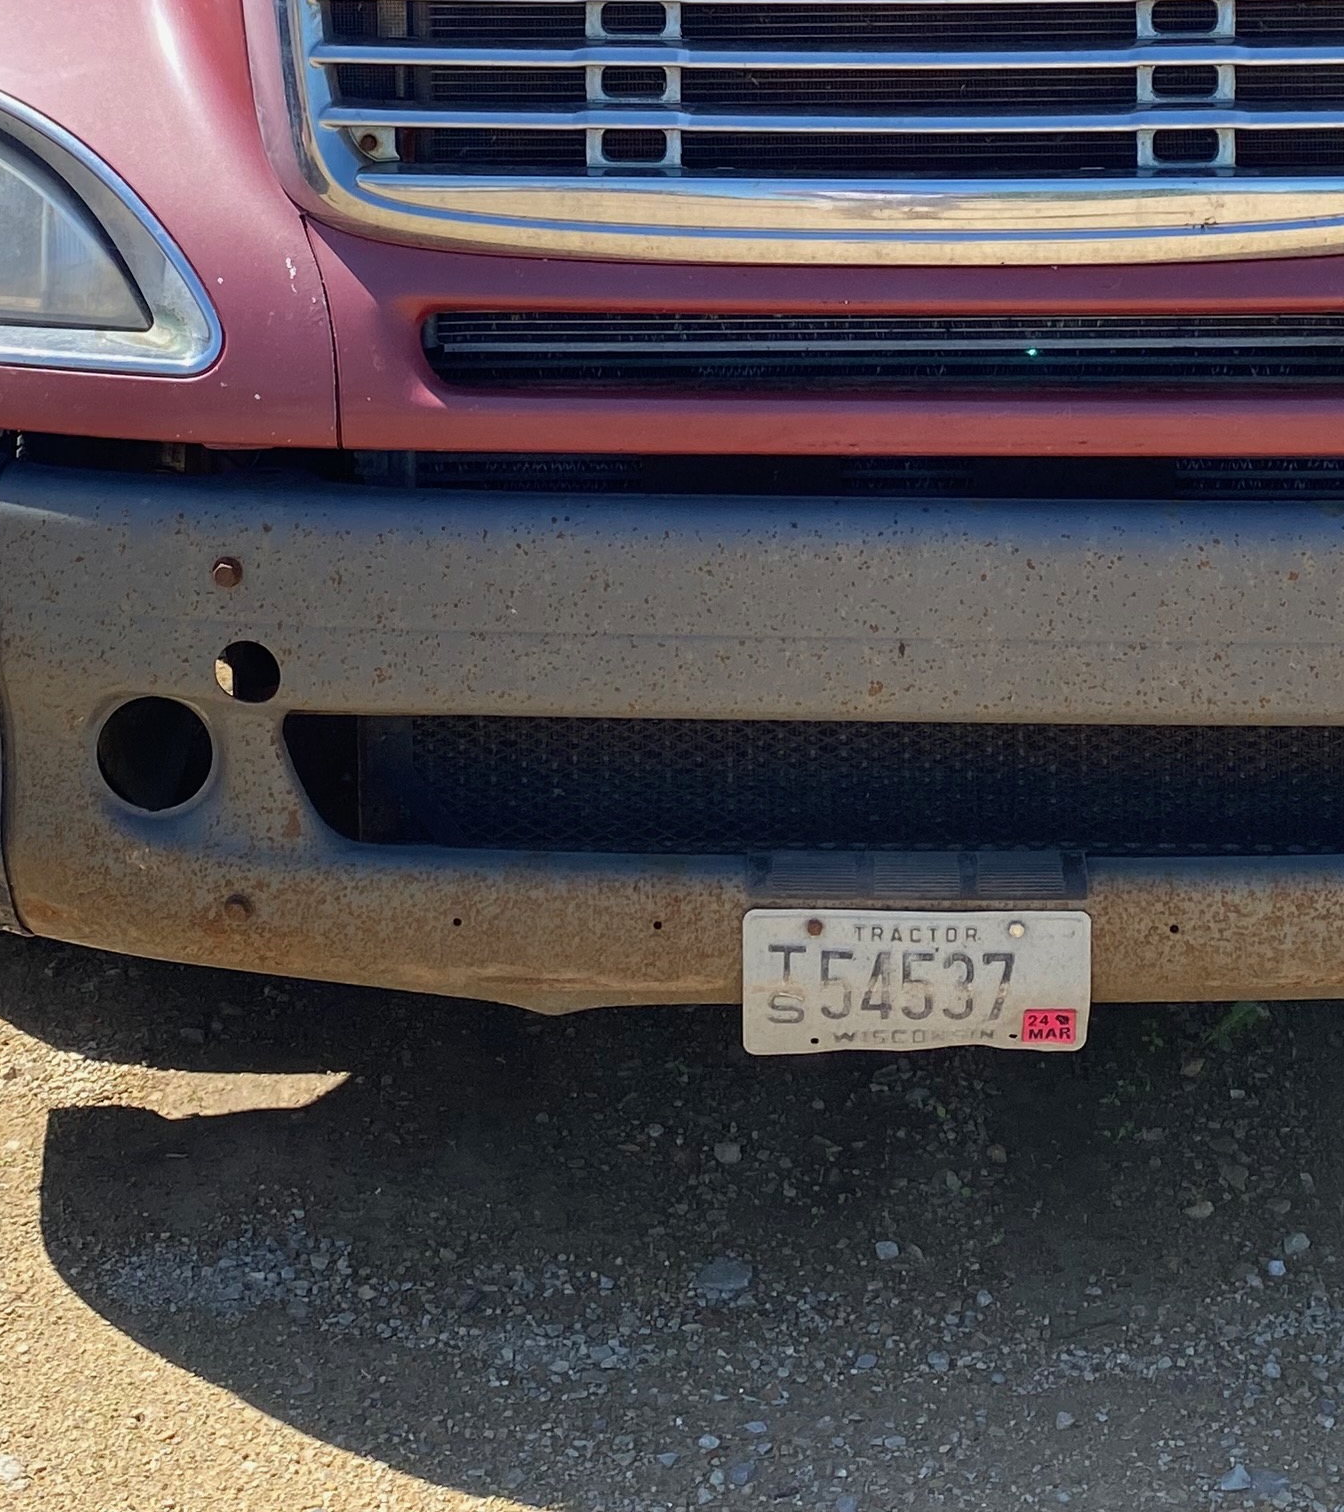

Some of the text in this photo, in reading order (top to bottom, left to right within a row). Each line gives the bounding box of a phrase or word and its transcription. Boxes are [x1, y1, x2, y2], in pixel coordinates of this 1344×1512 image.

[855, 926, 979, 943] TRACTOR
[1028, 1014, 1050, 1027] 24
[1029, 1027, 1071, 1040] MAR
